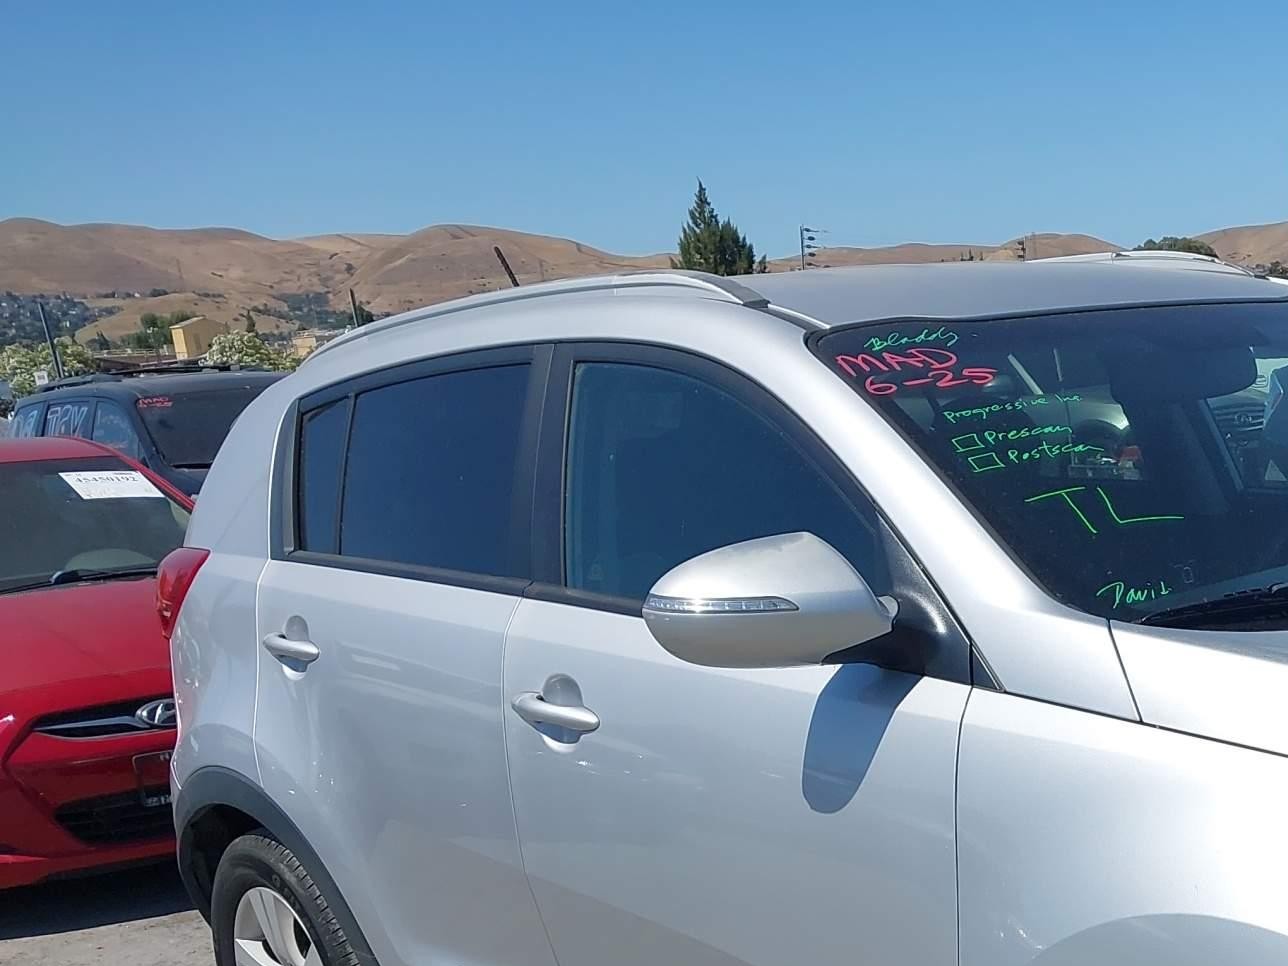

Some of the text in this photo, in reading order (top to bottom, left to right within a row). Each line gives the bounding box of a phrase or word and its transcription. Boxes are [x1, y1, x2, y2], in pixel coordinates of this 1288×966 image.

[835, 348, 957, 377] MAD
[865, 368, 998, 395] 6-25
[943, 397, 1049, 424] Progressive
[984, 424, 1073, 445] Prescan
